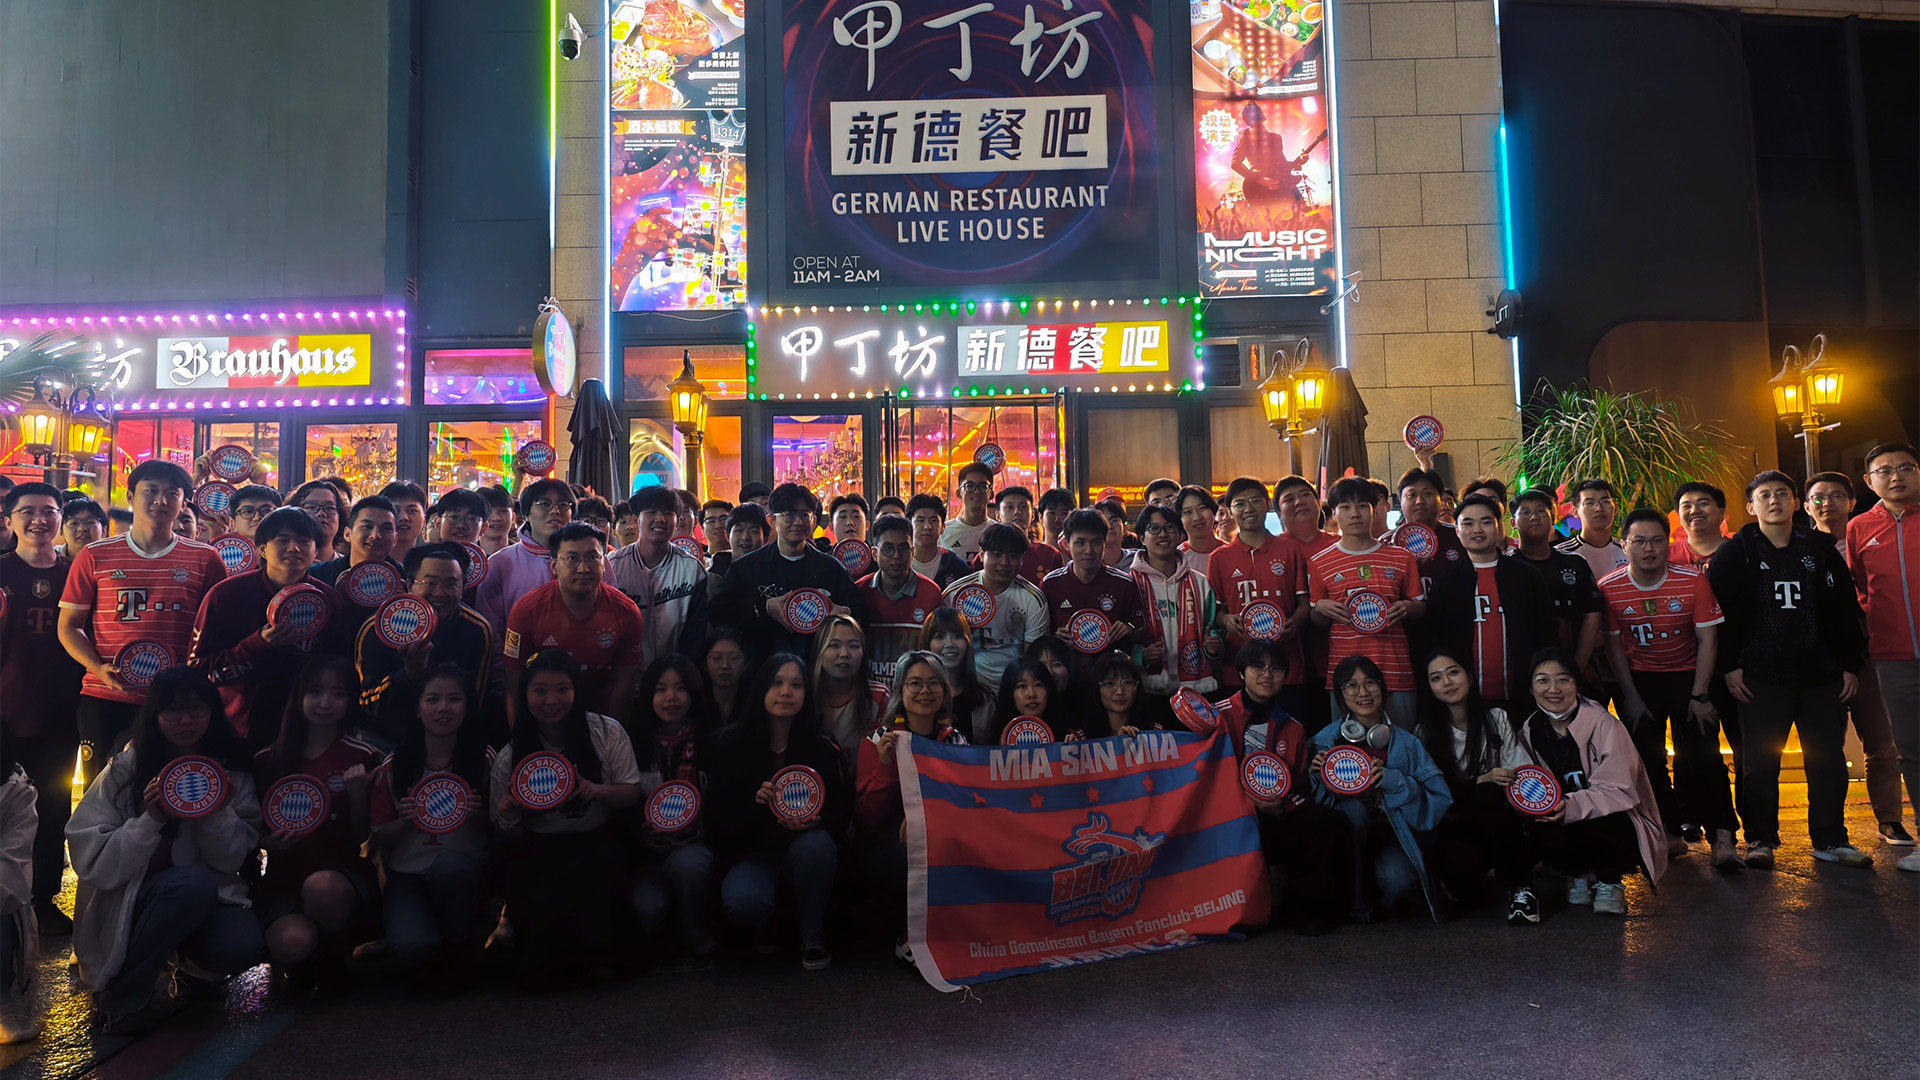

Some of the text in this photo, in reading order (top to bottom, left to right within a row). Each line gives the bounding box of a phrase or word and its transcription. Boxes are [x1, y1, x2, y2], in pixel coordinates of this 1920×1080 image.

[832, 0, 1104, 91] 甲丁坊
[1205, 114, 1231, 127] 现场
[716, 126, 739, 138] 1314
[846, 106, 1093, 165] 新德餐吧
[1206, 129, 1232, 142] 演艺
[831, 185, 1109, 215] GERMAN RESTAURANT
[897, 216, 1045, 244] LIVE HOUSE
[1203, 228, 1327, 247] MUSIC
[793, 255, 861, 270] OPEN AT
[1205, 244, 1327, 263] NIGHT
[793, 270, 831, 284] 11AM
[844, 269, 880, 283] 2AM
[168, 337, 357, 387] Brauhaus
[780, 324, 1161, 382] 甲丁坊 新德餐吧
[224, 540, 250, 556] BAYERN
[1352, 595, 1385, 611] FC BAYERN
[390, 602, 426, 626] FC BAYERN
[1078, 615, 1104, 626] BAYERN
[131, 646, 144, 655] FC
[1012, 724, 1048, 744] FC BAYERN
[989, 732, 1180, 781] MIA SAN MIA
[523, 759, 566, 780] FC BAYERN
[1250, 758, 1284, 780] FC BAYERN
[1328, 768, 1366, 788] FC BAYERN
[192, 765, 218, 810] FC BAYERN
[418, 780, 460, 807] FC BAYERN
[777, 774, 817, 795] FC BAYERN
[277, 784, 320, 809] FC BAYERN
[659, 788, 694, 810] FC BAYERN
[1522, 783, 1554, 809] FC BAYERN
[969, 940, 1005, 958] China
[1009, 931, 1088, 953] Gemeinsam
